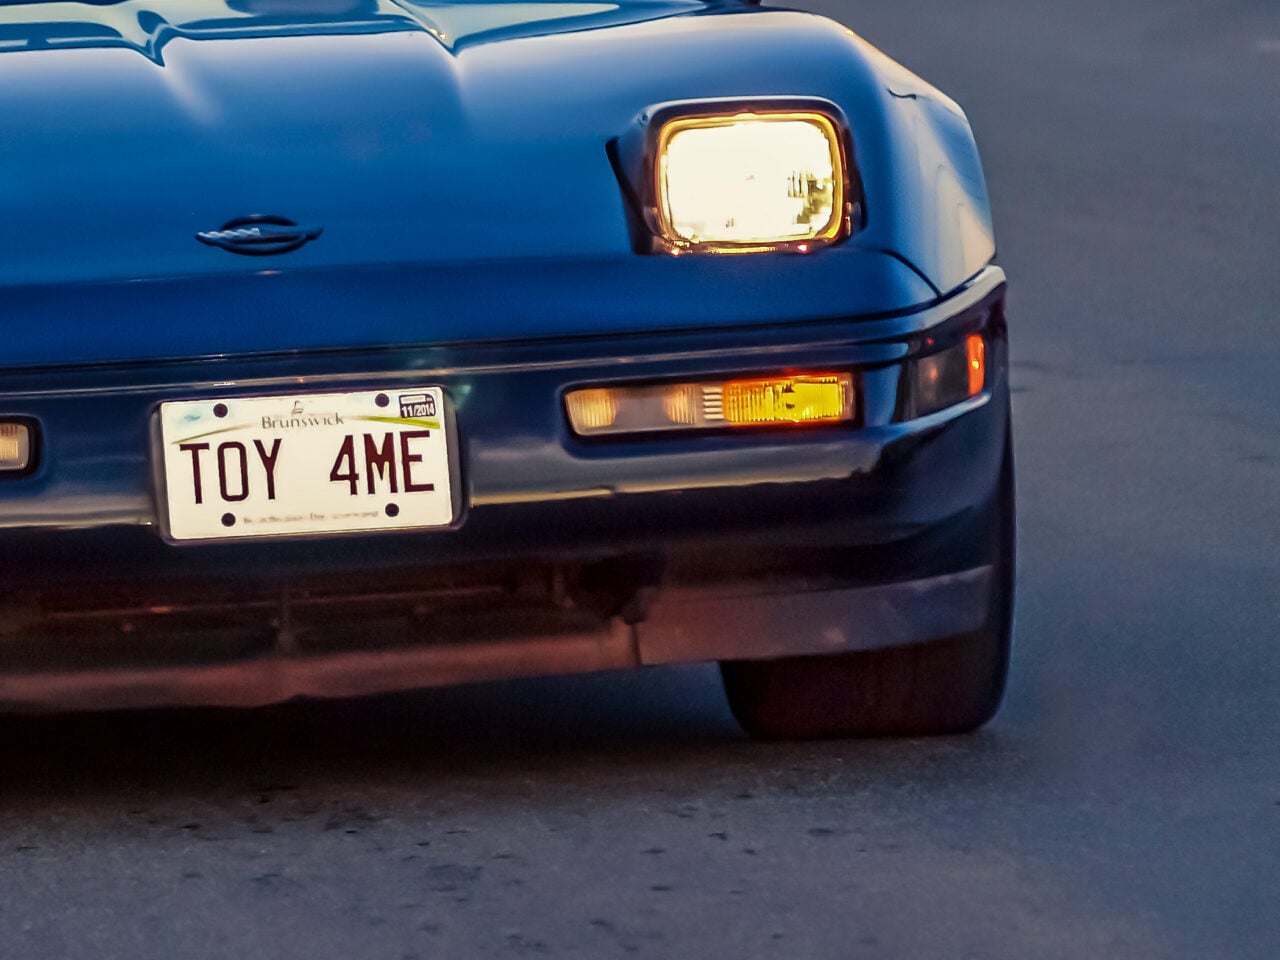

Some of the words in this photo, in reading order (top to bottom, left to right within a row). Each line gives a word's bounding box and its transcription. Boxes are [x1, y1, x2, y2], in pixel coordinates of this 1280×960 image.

[402, 403, 435, 418] 11/2014
[261, 412, 345, 429] Brunswick
[179, 438, 282, 504] TOY
[329, 430, 435, 496] 4ME
